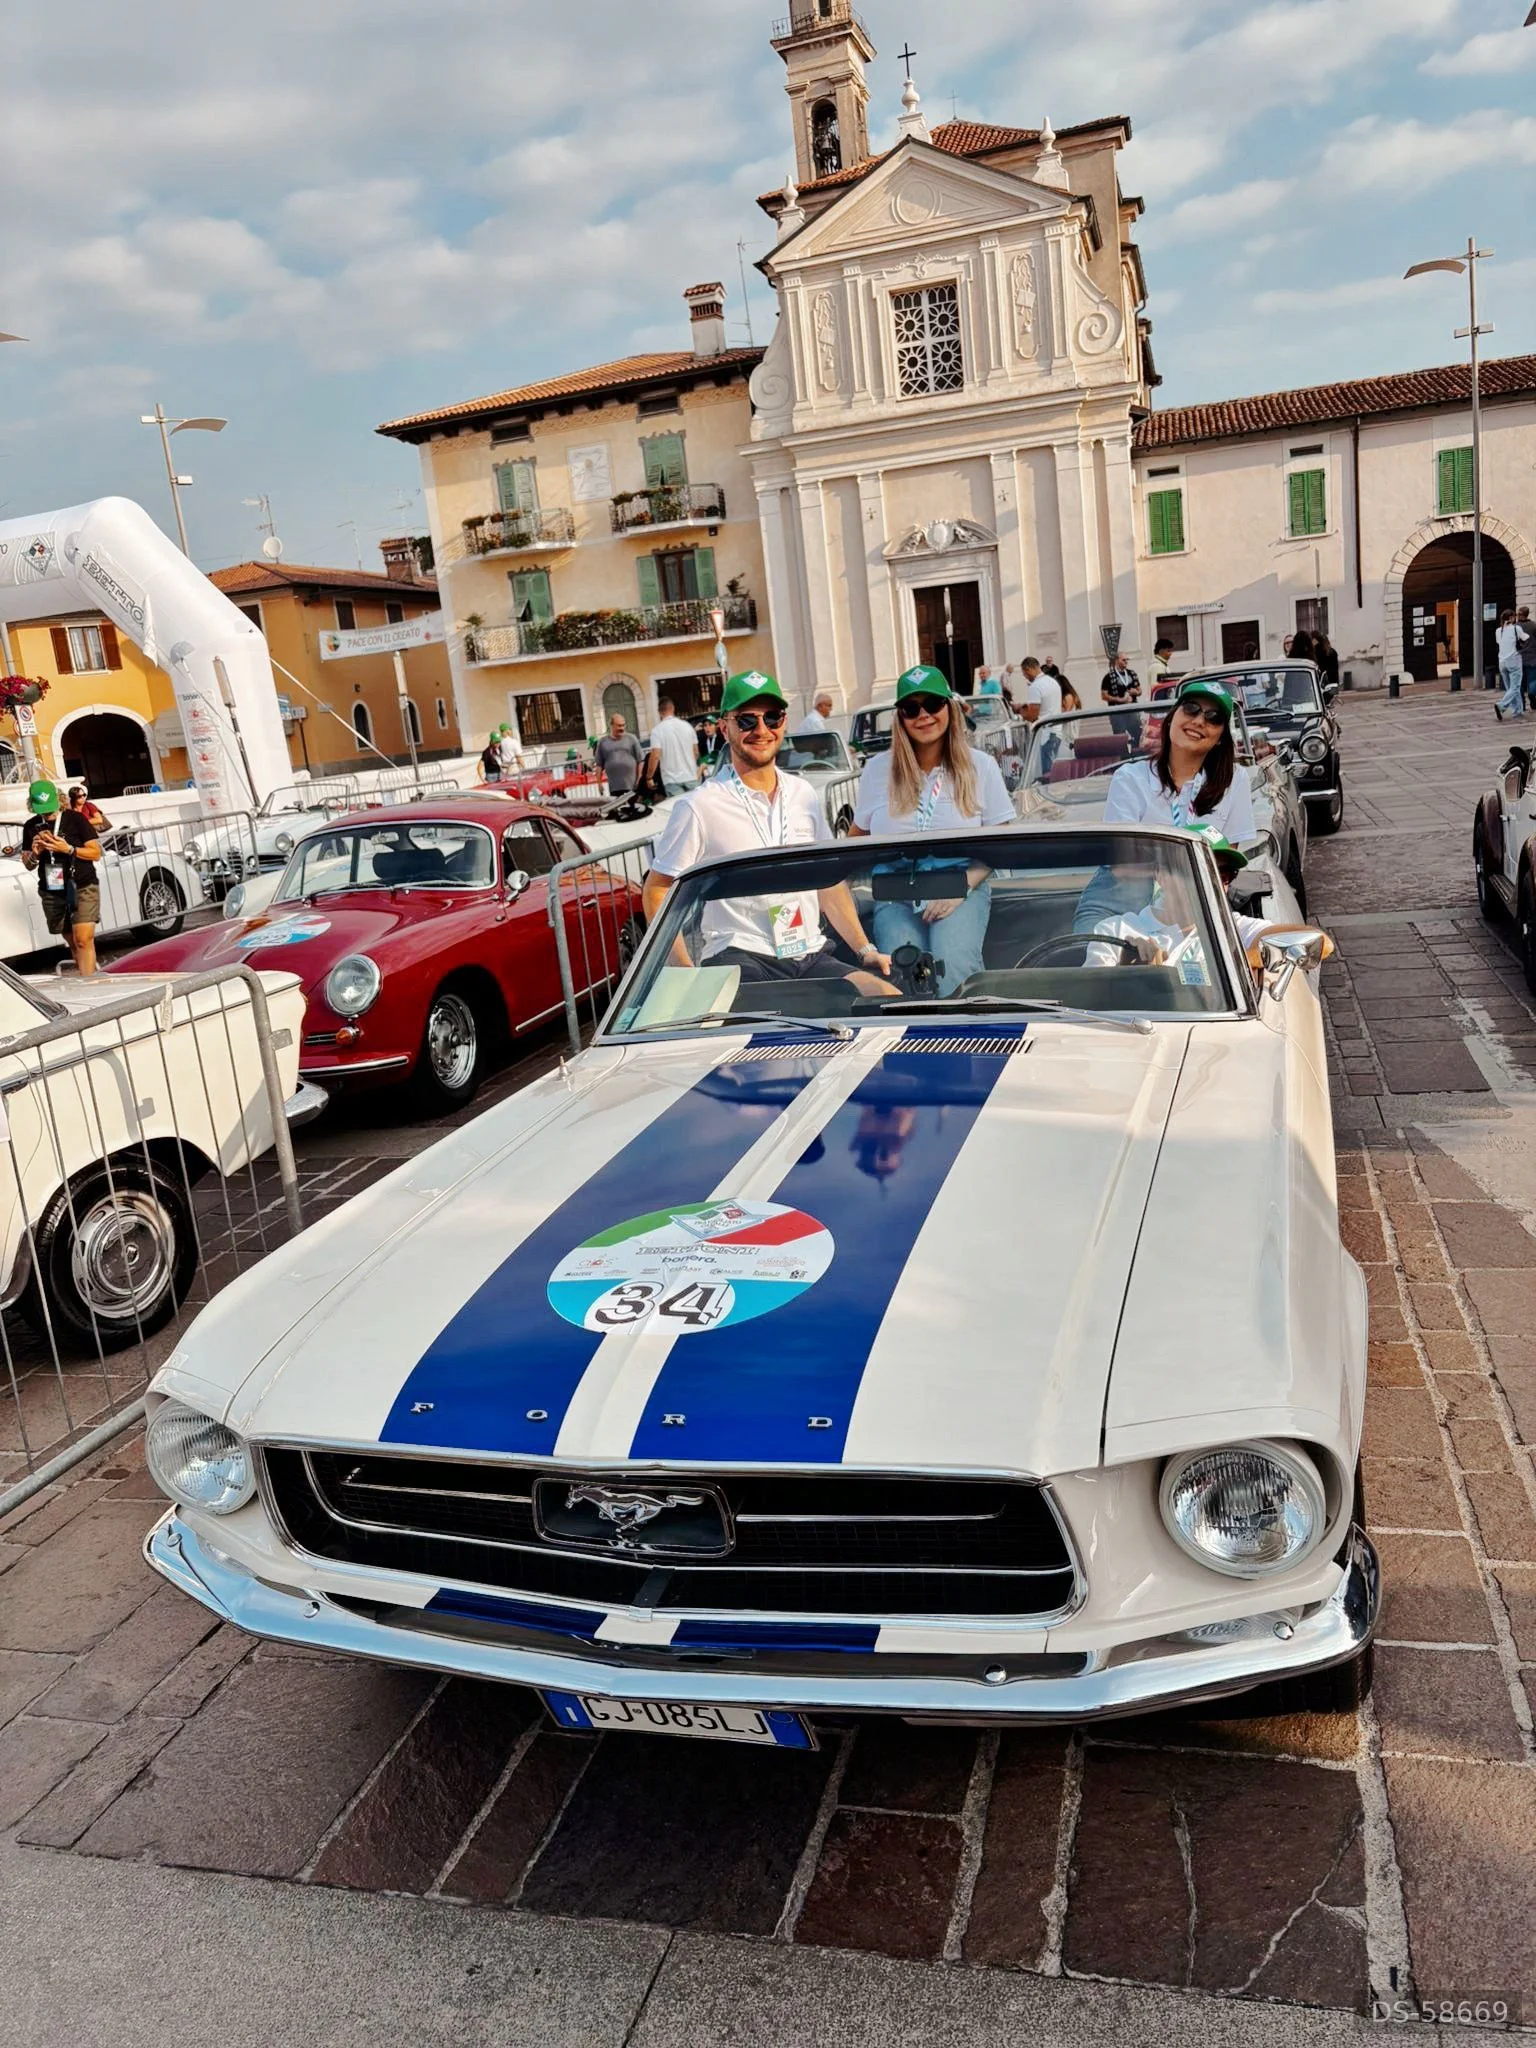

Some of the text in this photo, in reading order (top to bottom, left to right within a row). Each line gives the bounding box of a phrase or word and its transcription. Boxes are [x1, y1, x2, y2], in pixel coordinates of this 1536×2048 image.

[82, 554, 145, 627] BETTO
[347, 637, 367, 648] PACE
[368, 635, 383, 646] CON
[384, 634, 391, 644] IL
[393, 628, 421, 642] CREATO
[781, 942, 804, 956] 2025
[595, 1281, 730, 1325] 34
[410, 1401, 833, 1430] FORD
[641, 1702, 769, 1736] 085LJ
